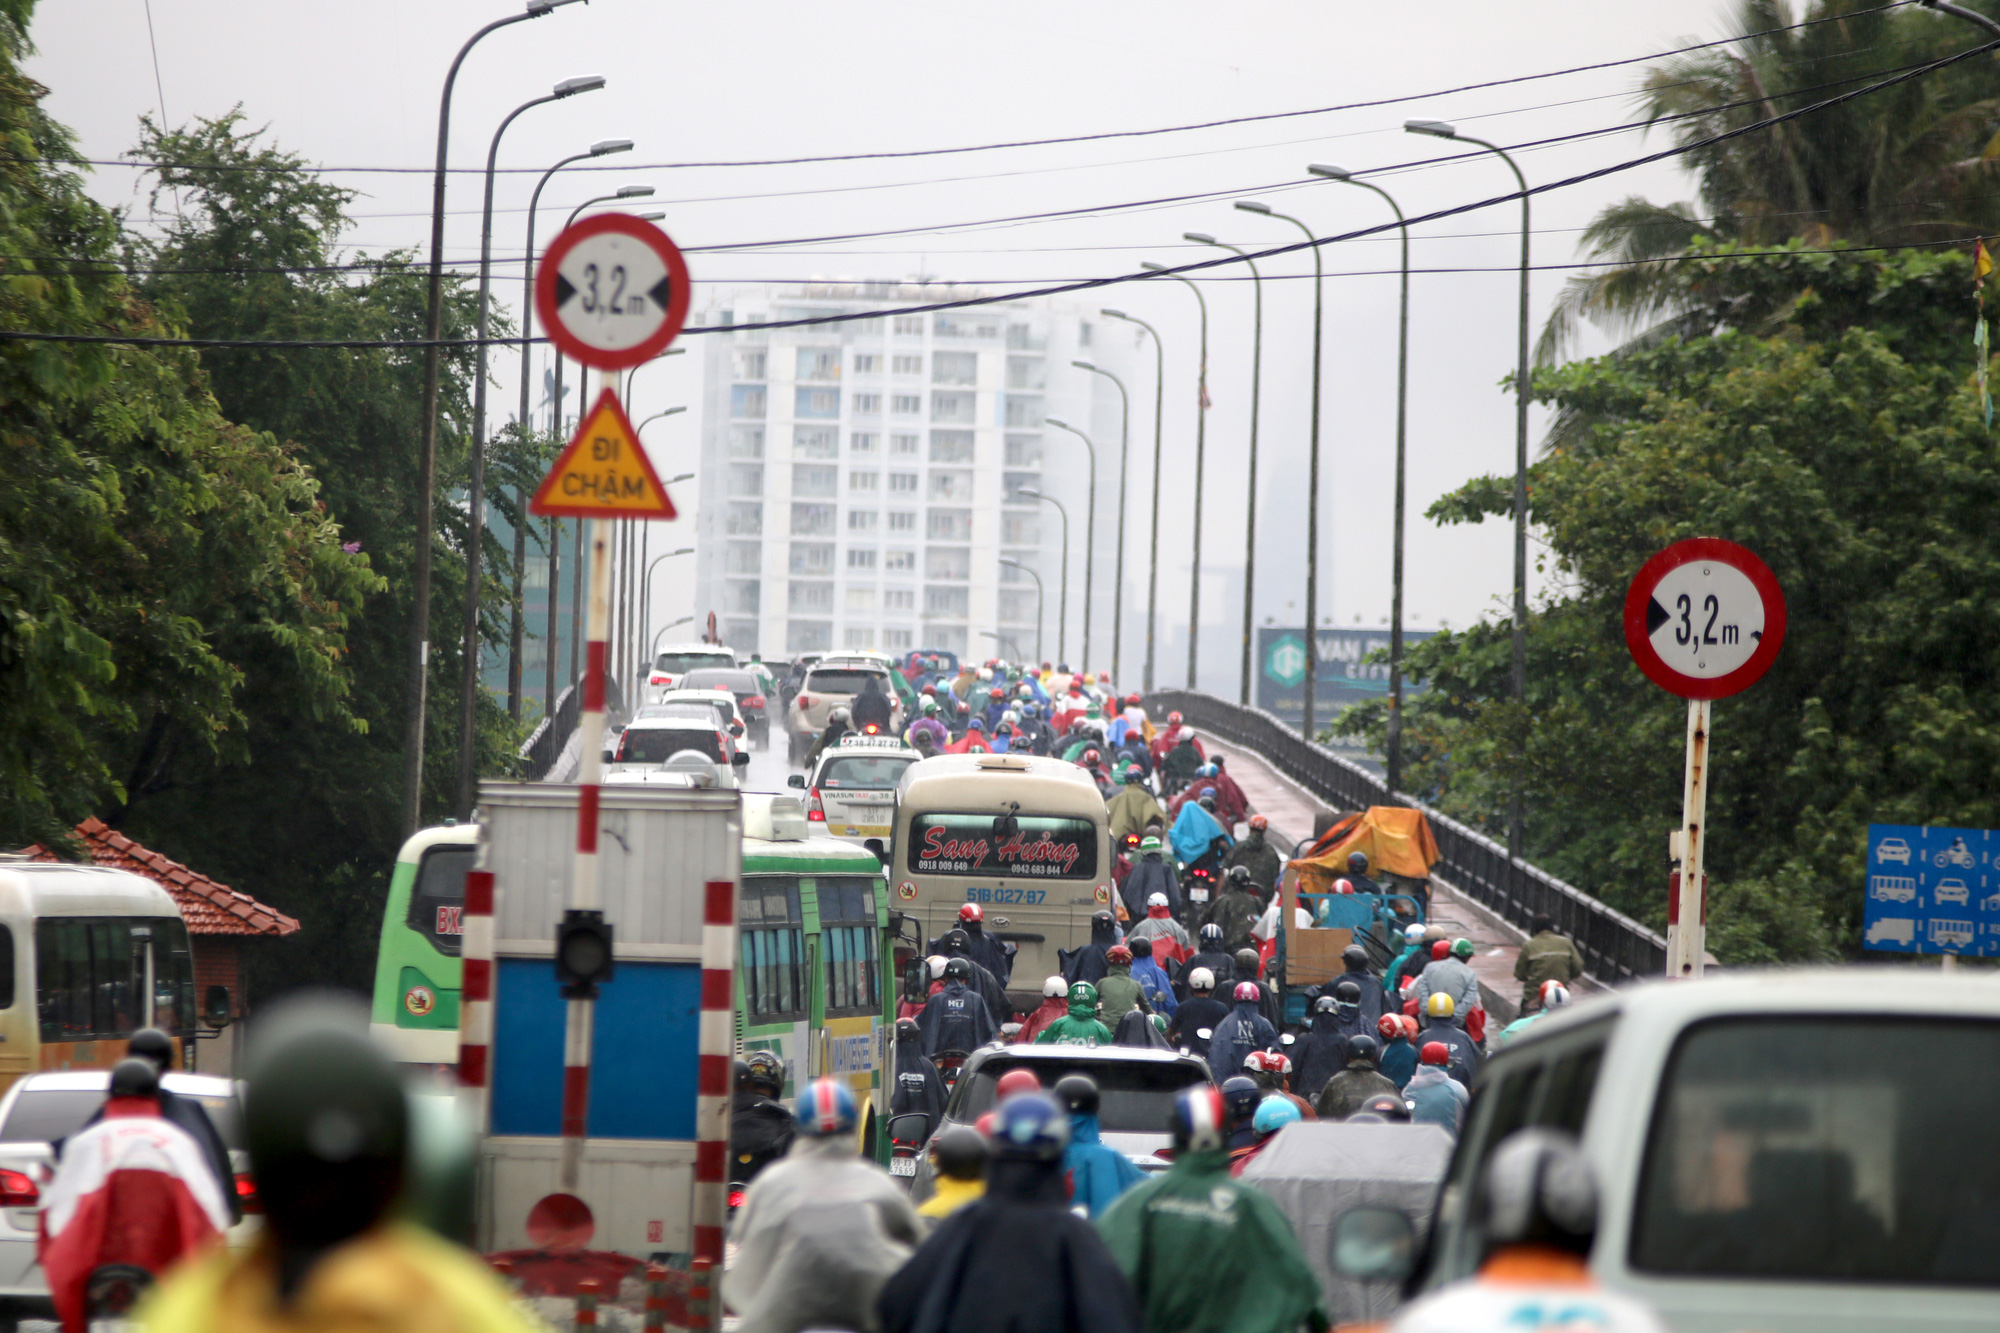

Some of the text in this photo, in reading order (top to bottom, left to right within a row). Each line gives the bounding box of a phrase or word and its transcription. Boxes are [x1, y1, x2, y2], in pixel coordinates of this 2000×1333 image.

[592, 437, 620, 462] ĐI
[1315, 638, 1360, 662] VAN
[921, 825, 990, 869] Sang
[918, 860, 968, 871] 0918 009 649
[1011, 864, 1061, 875] 0942 683 844
